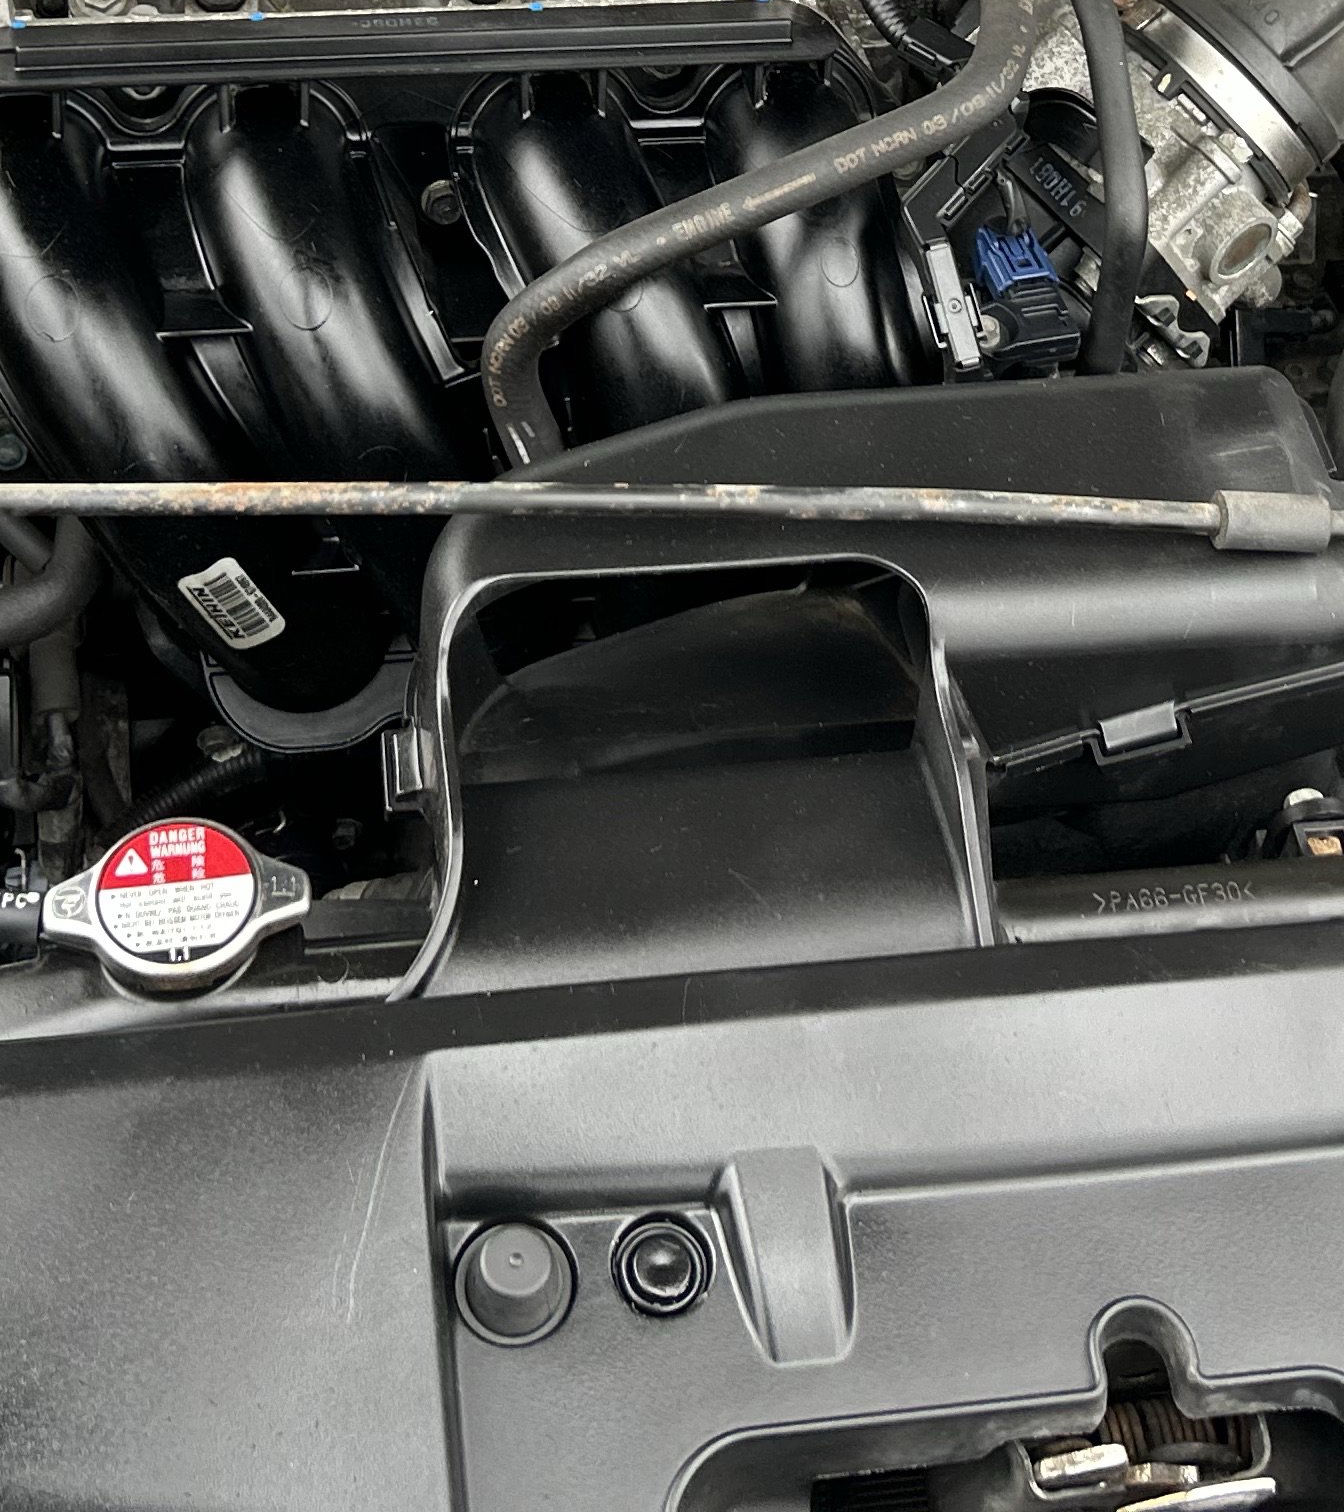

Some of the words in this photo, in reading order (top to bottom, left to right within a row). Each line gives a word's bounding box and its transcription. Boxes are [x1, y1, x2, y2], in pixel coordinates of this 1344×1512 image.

[833, 147, 867, 174] DOT
[671, 201, 737, 241] ENGINE
[148, 826, 206, 846] DANGER
[150, 841, 206, 859] WARNUNG
[1092, 879, 1256, 915] >PA66-GF30<
[169, 945, 191, 963] 1.1
